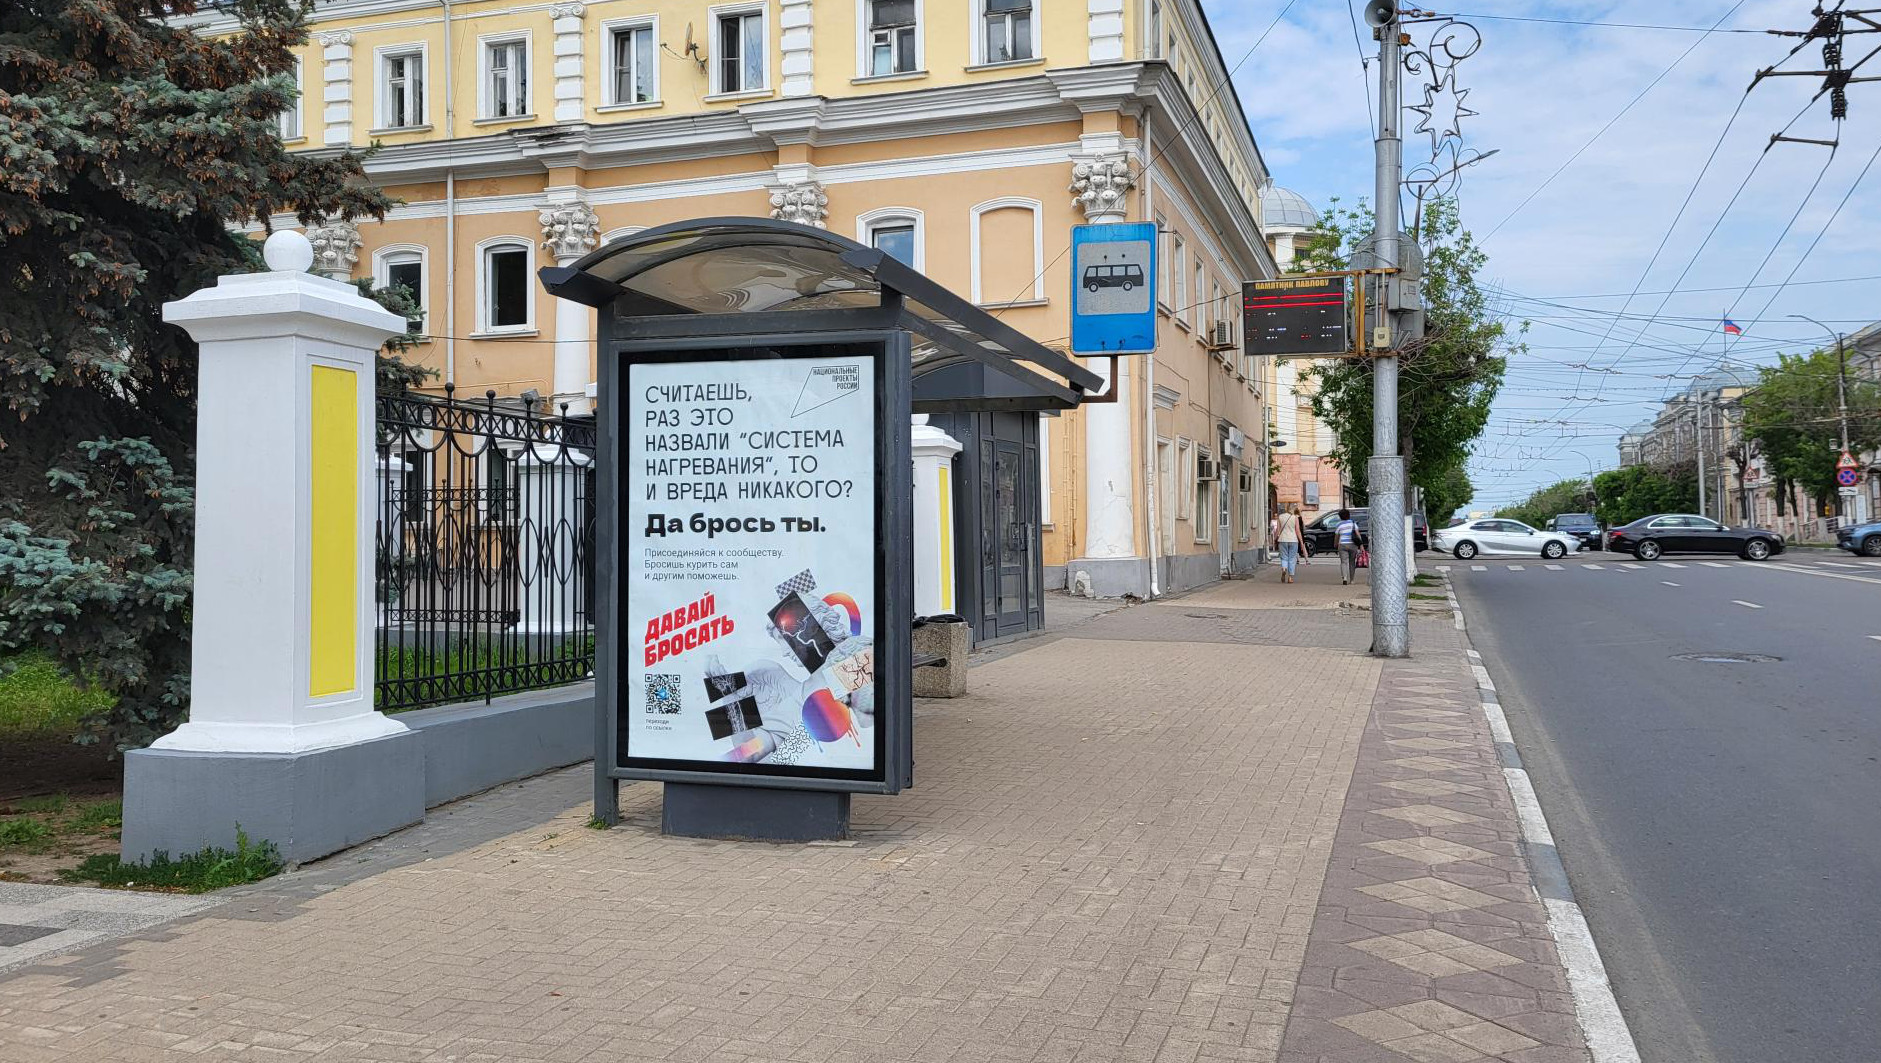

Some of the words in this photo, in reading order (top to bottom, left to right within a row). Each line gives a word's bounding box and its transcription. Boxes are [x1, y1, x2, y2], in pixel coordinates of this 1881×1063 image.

[1255, 281, 1294, 290] ПАМЯТНИК
[1296, 279, 1329, 288] ПАВЛОВУ
[813, 367, 858, 375] НАЦИОНАЛЬНЫЕ
[832, 374, 858, 382] ПРОЕКТЫ
[645, 383, 752, 403] СЧИТАЕШЬ,
[837, 382, 858, 390] РОССИИ
[645, 410, 680, 427] РАЗ
[690, 408, 734, 426] ЭТО
[645, 433, 729, 452] НАЗВАЛИ
[788, 455, 818, 473] ТО
[646, 483, 656, 500] И
[667, 482, 728, 502] ВРЕДА
[738, 480, 853, 499] НИКАКОГО?
[645, 514, 683, 537] Да
[689, 512, 776, 539] брось
[780, 516, 826, 533] ты.
[644, 548, 716, 560] Присоединяйся
[719, 549, 725, 557] к
[726, 548, 784, 560] сообществу.
[644, 560, 684, 570] Бросишь
[687, 561, 718, 570] курить
[720, 561, 739, 569] сам
[652, 572, 685, 581] другим
[687, 571, 739, 580] поможешь.
[645, 591, 716, 644] ДАВАЙ
[644, 614, 735, 667] БРОСАТЬ
